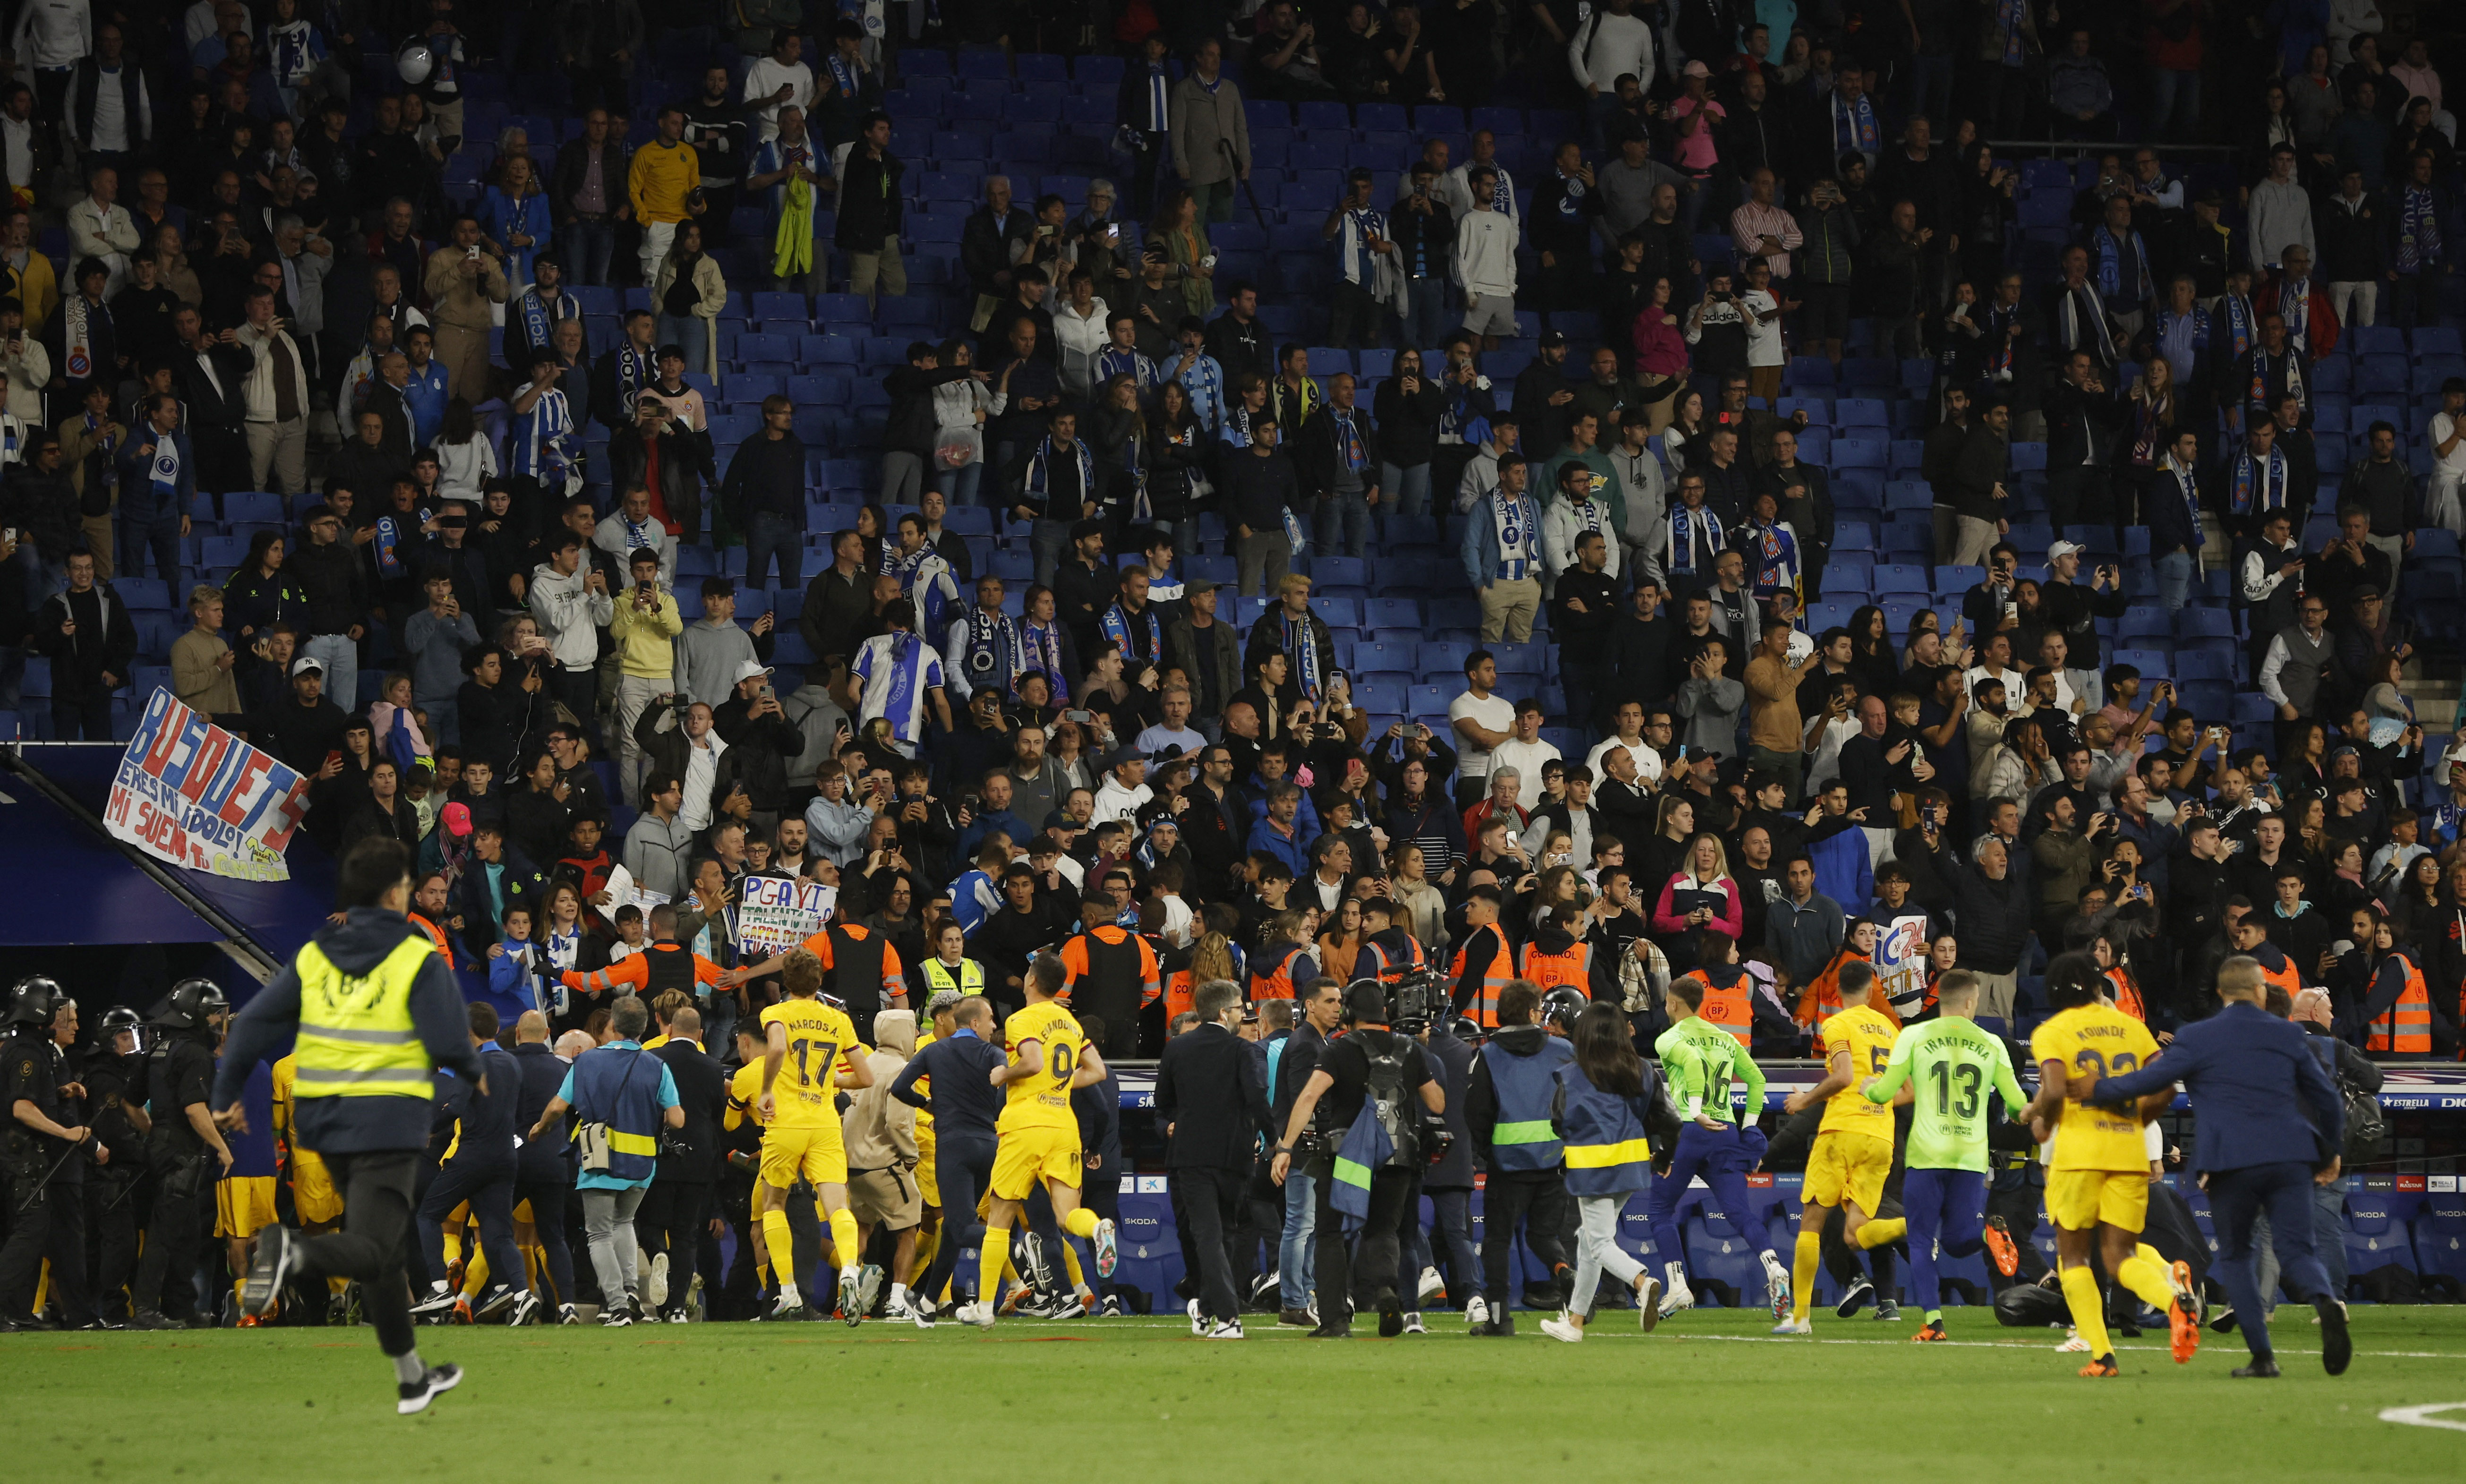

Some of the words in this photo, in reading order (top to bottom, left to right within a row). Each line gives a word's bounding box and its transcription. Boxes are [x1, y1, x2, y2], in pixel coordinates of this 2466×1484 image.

[1703, 311, 1740, 322] adidas
[532, 309, 549, 348] RCD
[117, 760, 159, 802] ERES
[127, 688, 312, 853] BUSQUETS
[742, 906, 804, 929] TALENTO
[18, 985, 28, 996] 5
[1550, 974, 1562, 985] BP
[172, 990, 180, 1000] 5
[1712, 1002, 1724, 1015] BP
[788, 1019, 829, 1032] MARCOS
[830, 1026, 839, 1038] A.
[1860, 1023, 1892, 1039] SERGIO
[1708, 1036, 1737, 1058] TENAS
[1924, 1036, 1959, 1054] IÑAKI
[1961, 1039, 1990, 1061] PEÑA
[791, 1038, 837, 1088] 17
[1052, 1042, 1074, 1093] 9
[1871, 1044, 1890, 1075] 5
[1929, 1060, 1982, 1121] 13
[2393, 1099, 2429, 1108] ESTRELLA
